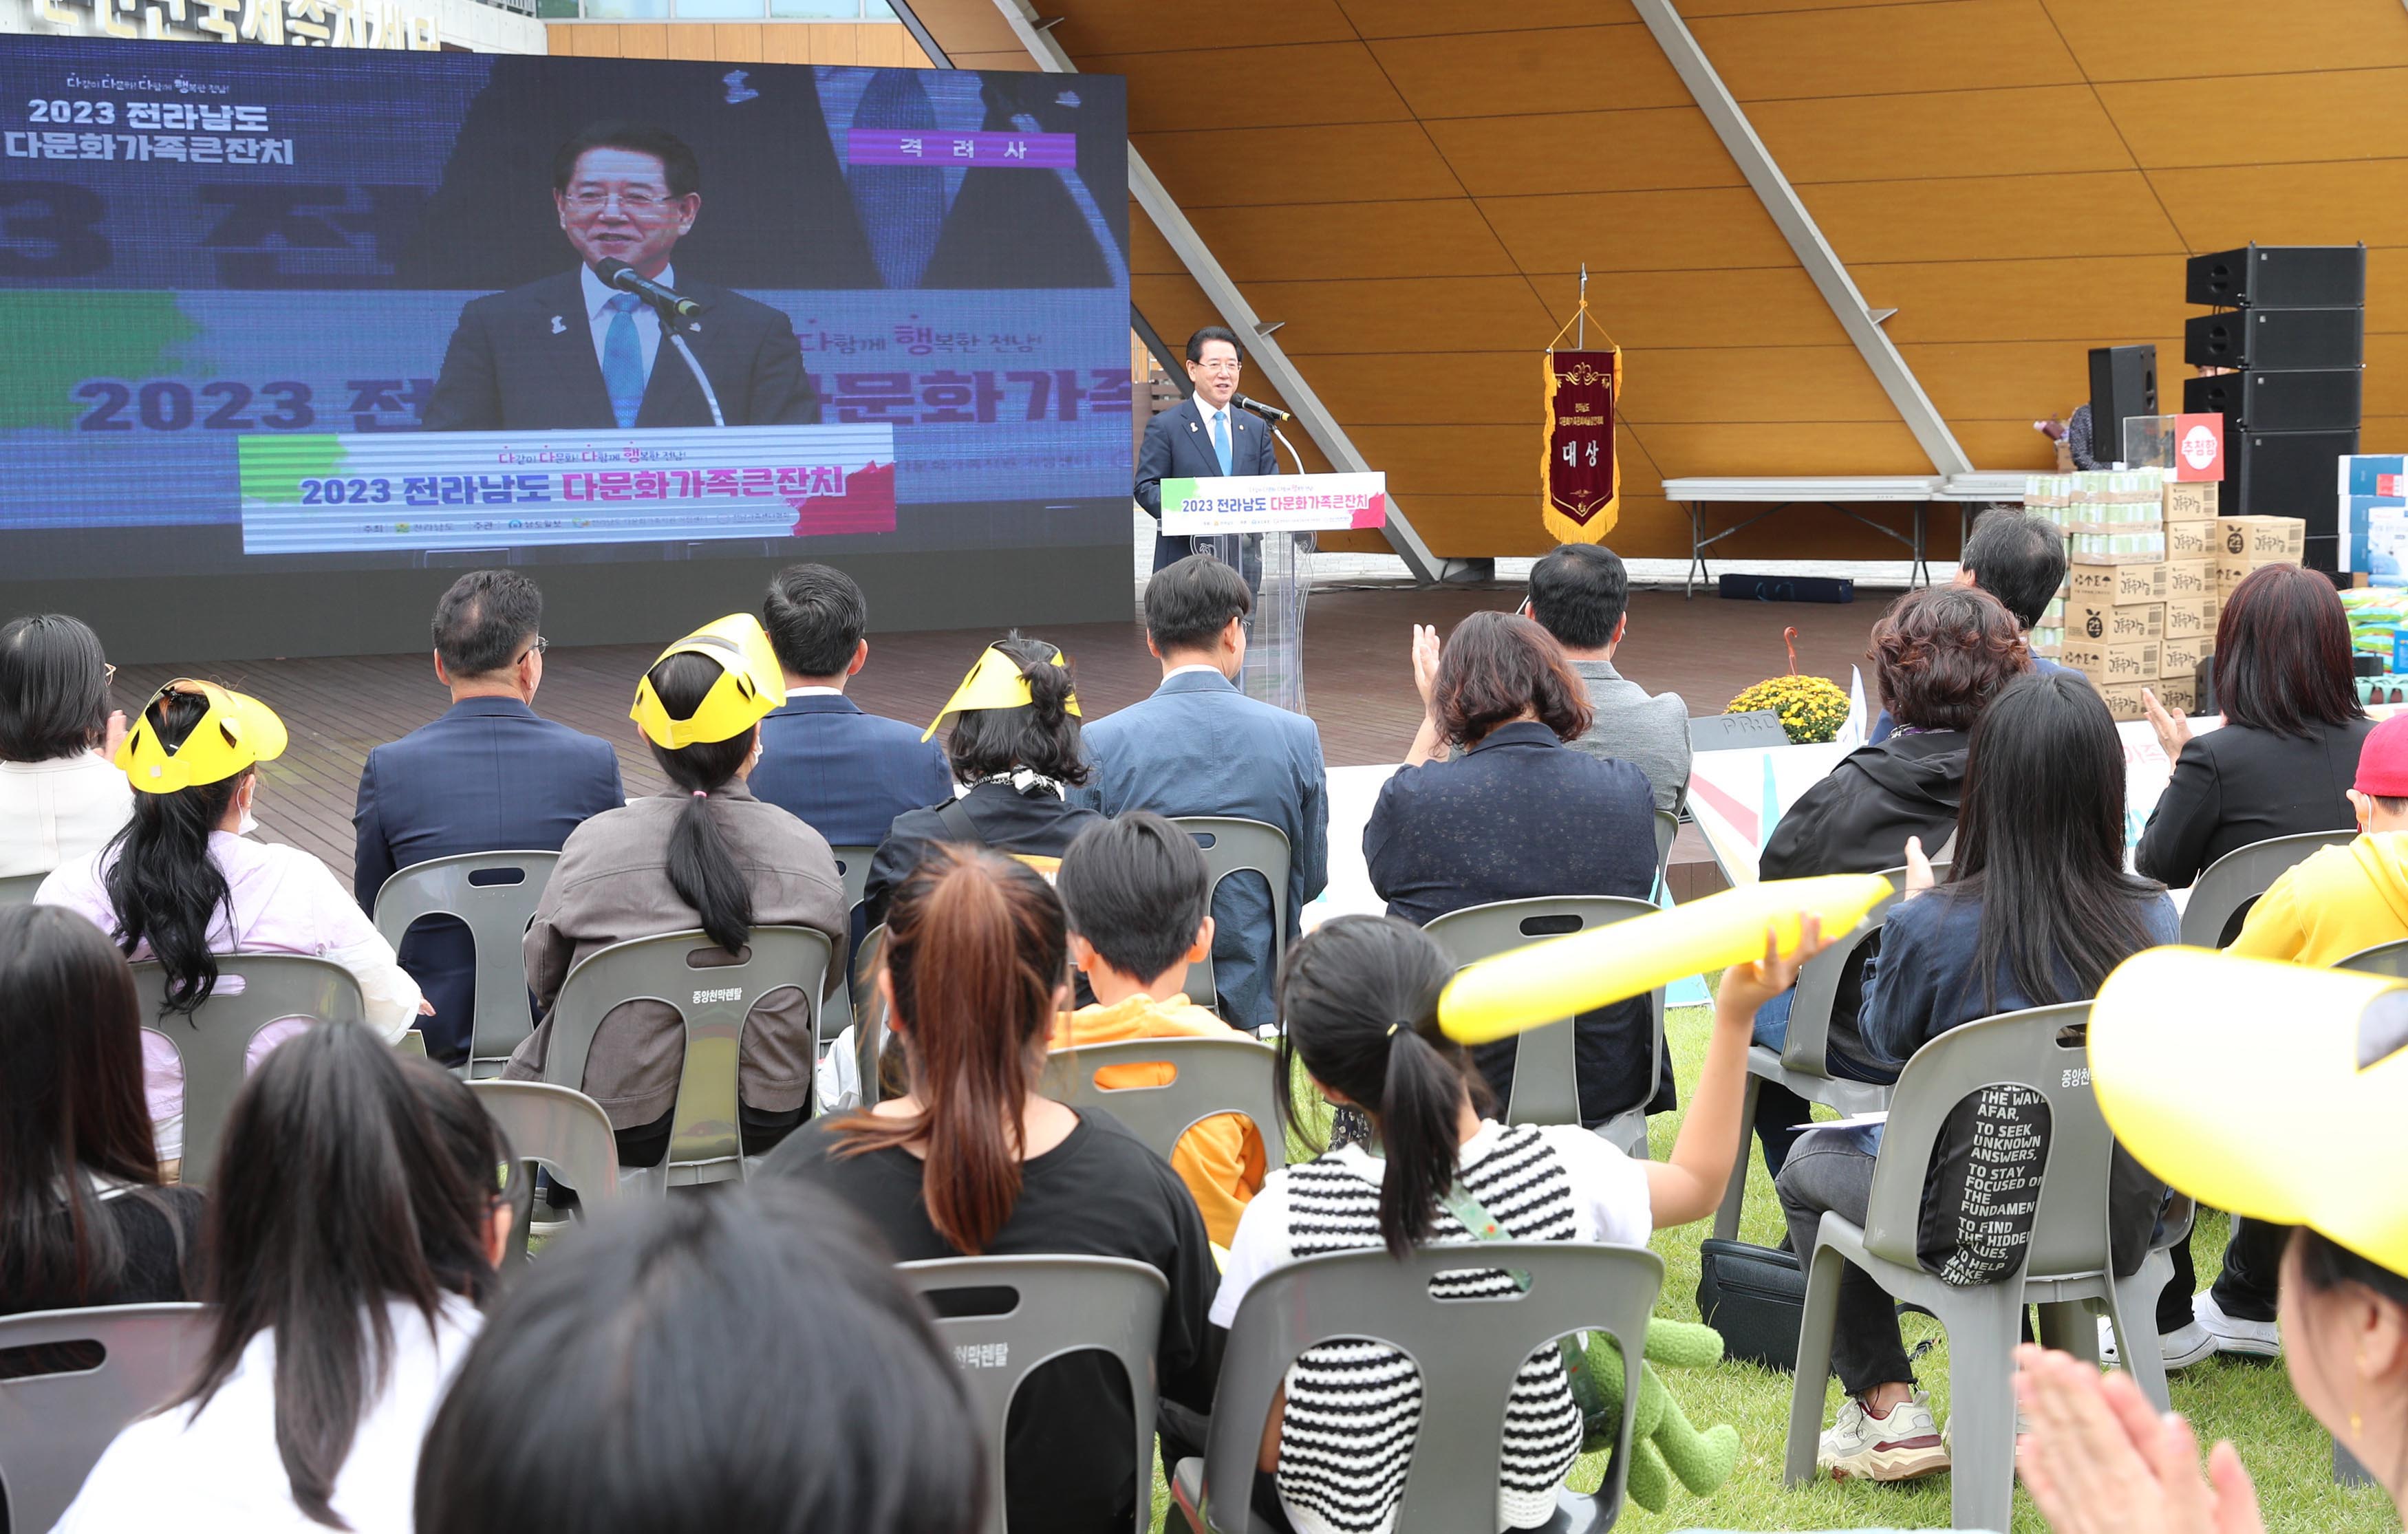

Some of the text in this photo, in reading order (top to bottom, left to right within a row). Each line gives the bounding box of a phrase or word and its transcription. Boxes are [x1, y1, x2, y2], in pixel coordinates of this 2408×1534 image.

[28, 99, 269, 131] 2023 전라남도
[4, 131, 294, 165] 다문화가족큰잔치
[894, 325, 980, 356] 행복한
[76, 381, 316, 431] 2023
[499, 449, 536, 465] 다같이
[623, 446, 660, 464] 행복한
[2183, 439, 2216, 457] 추첨함
[301, 466, 843, 506] 2023 전라남도 다문화가족큰잔치
[1183, 494, 1368, 512] 2023 전라남도 다문화가족큰잔치
[693, 987, 742, 1004] 중앙천막렌탈
[2062, 1068, 2095, 1088] 중앙천
[1981, 1090, 2008, 1105] THE
[1977, 1103, 2019, 1121] AFAR,
[1976, 1121, 2032, 1137] TO SEEK
[1973, 1134, 2041, 1150] UNKNOWN
[1970, 1147, 2036, 1163] ANSWERS,
[1968, 1163, 2025, 1180] TO STAY
[1966, 1175, 2025, 1192] FOCUSED
[1964, 1187, 1991, 1204] THE
[1959, 1216, 2013, 1233] TO FIND
[1958, 1227, 1983, 1242] THE
[1946, 1255, 1984, 1279] MAKE
[1957, 1245, 2005, 1271] TO HELP
